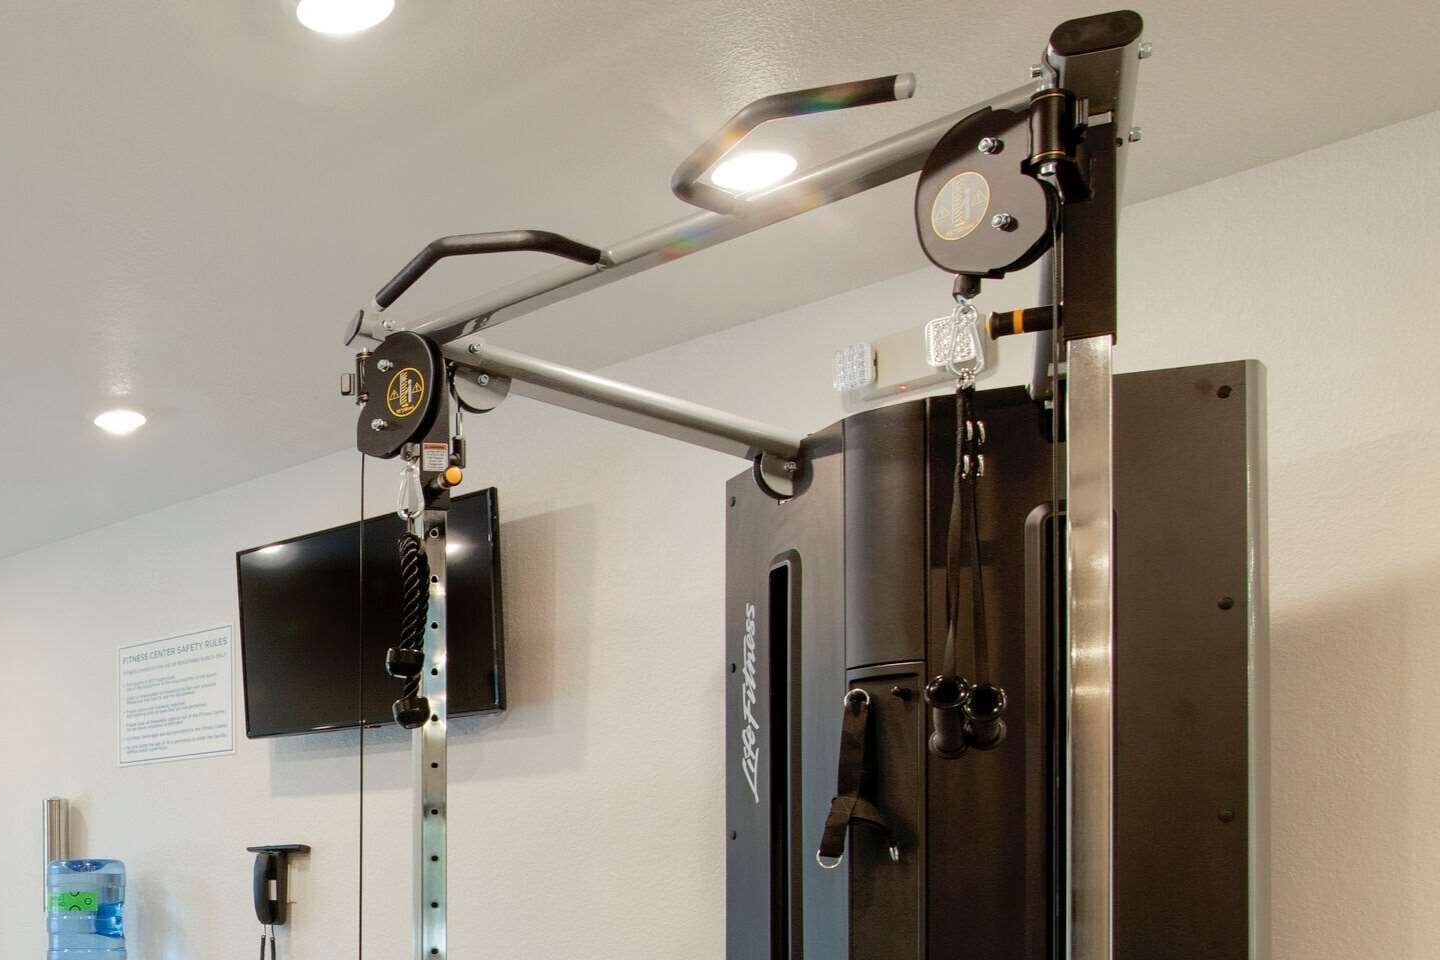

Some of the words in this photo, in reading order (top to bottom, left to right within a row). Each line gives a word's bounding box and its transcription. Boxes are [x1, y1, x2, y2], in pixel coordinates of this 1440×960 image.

[122, 652, 148, 665] FITNESS
[150, 647, 176, 660] CENTER
[177, 641, 203, 654] SAFETY
[204, 636, 228, 649] RULES
